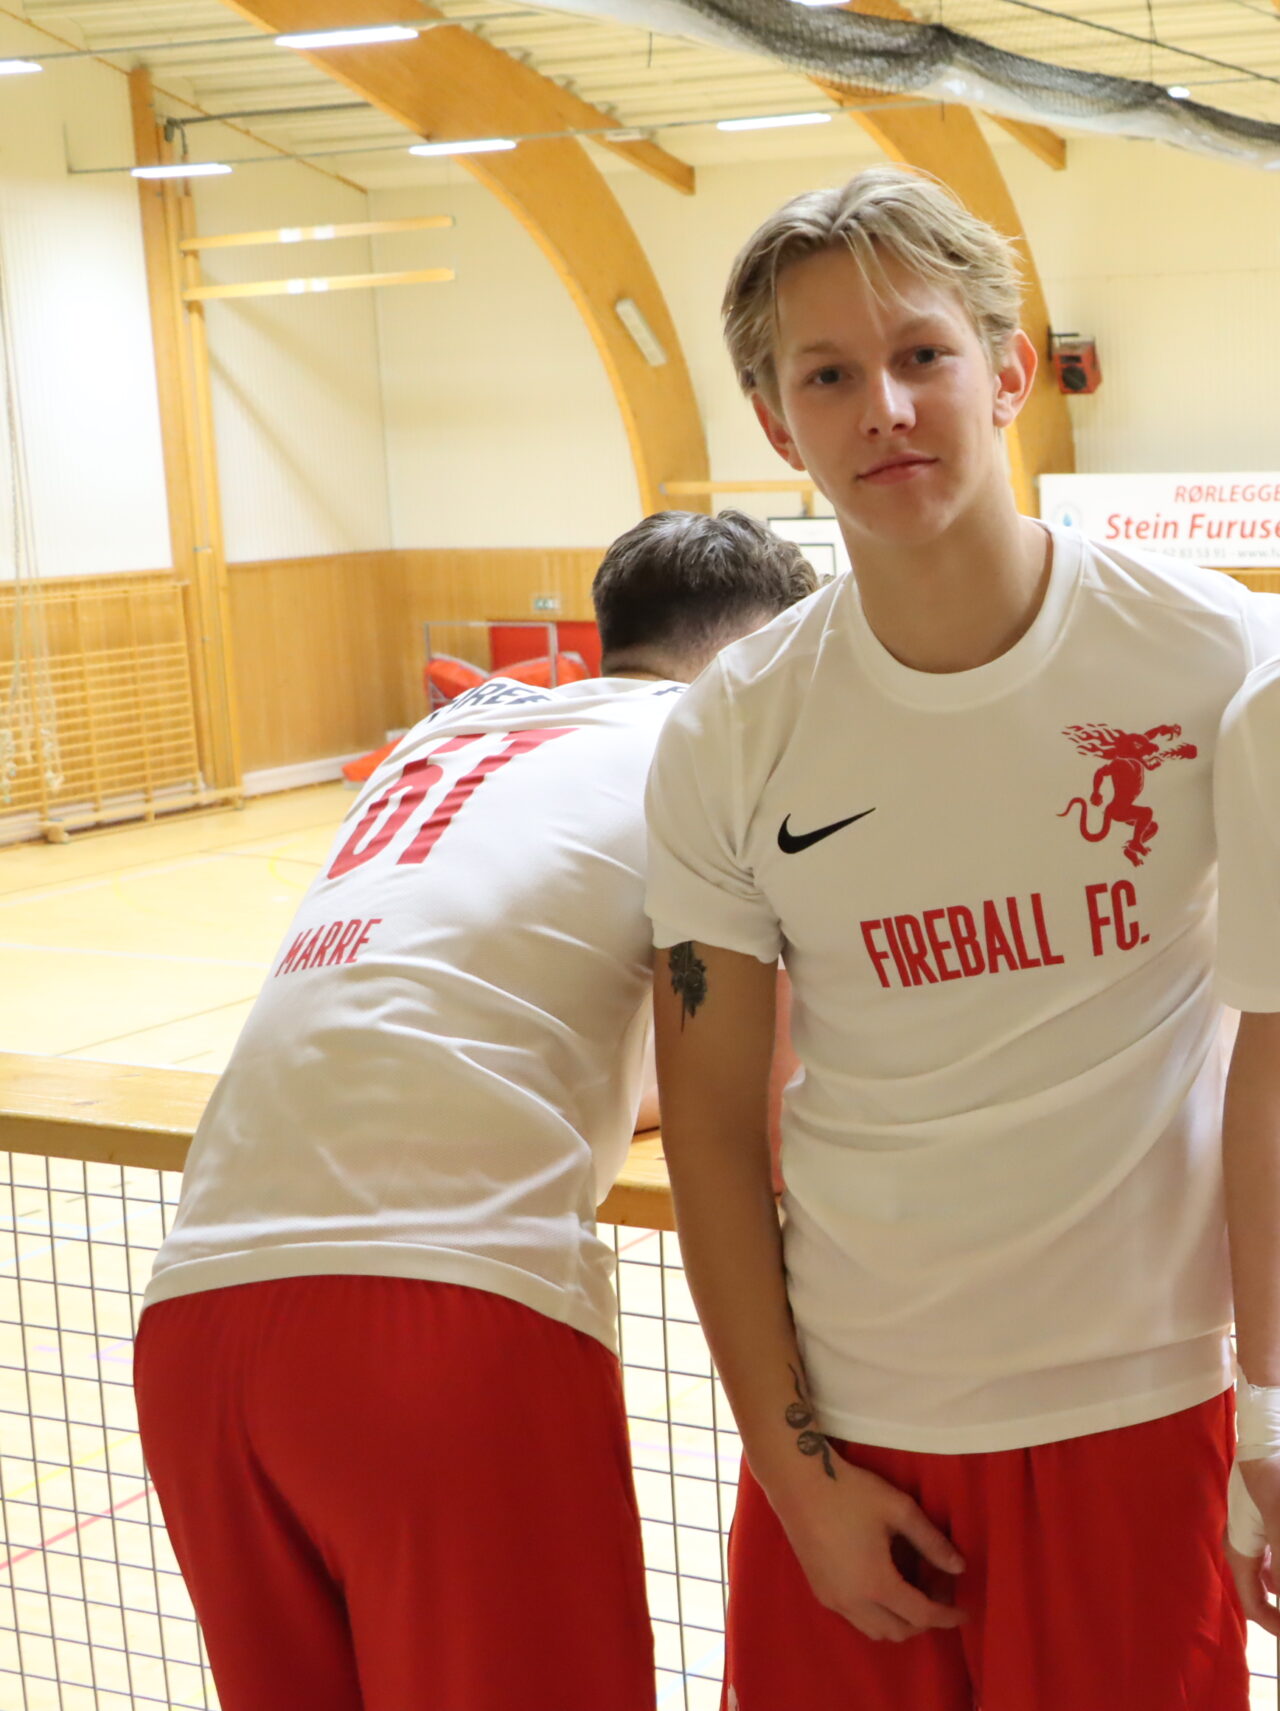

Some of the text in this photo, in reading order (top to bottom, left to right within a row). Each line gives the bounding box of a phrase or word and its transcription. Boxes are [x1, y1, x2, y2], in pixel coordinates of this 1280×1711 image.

[1105, 513, 1180, 540] Stein
[274, 918, 383, 978] MARRE
[860, 879, 1151, 988] FIREBALL FC.
